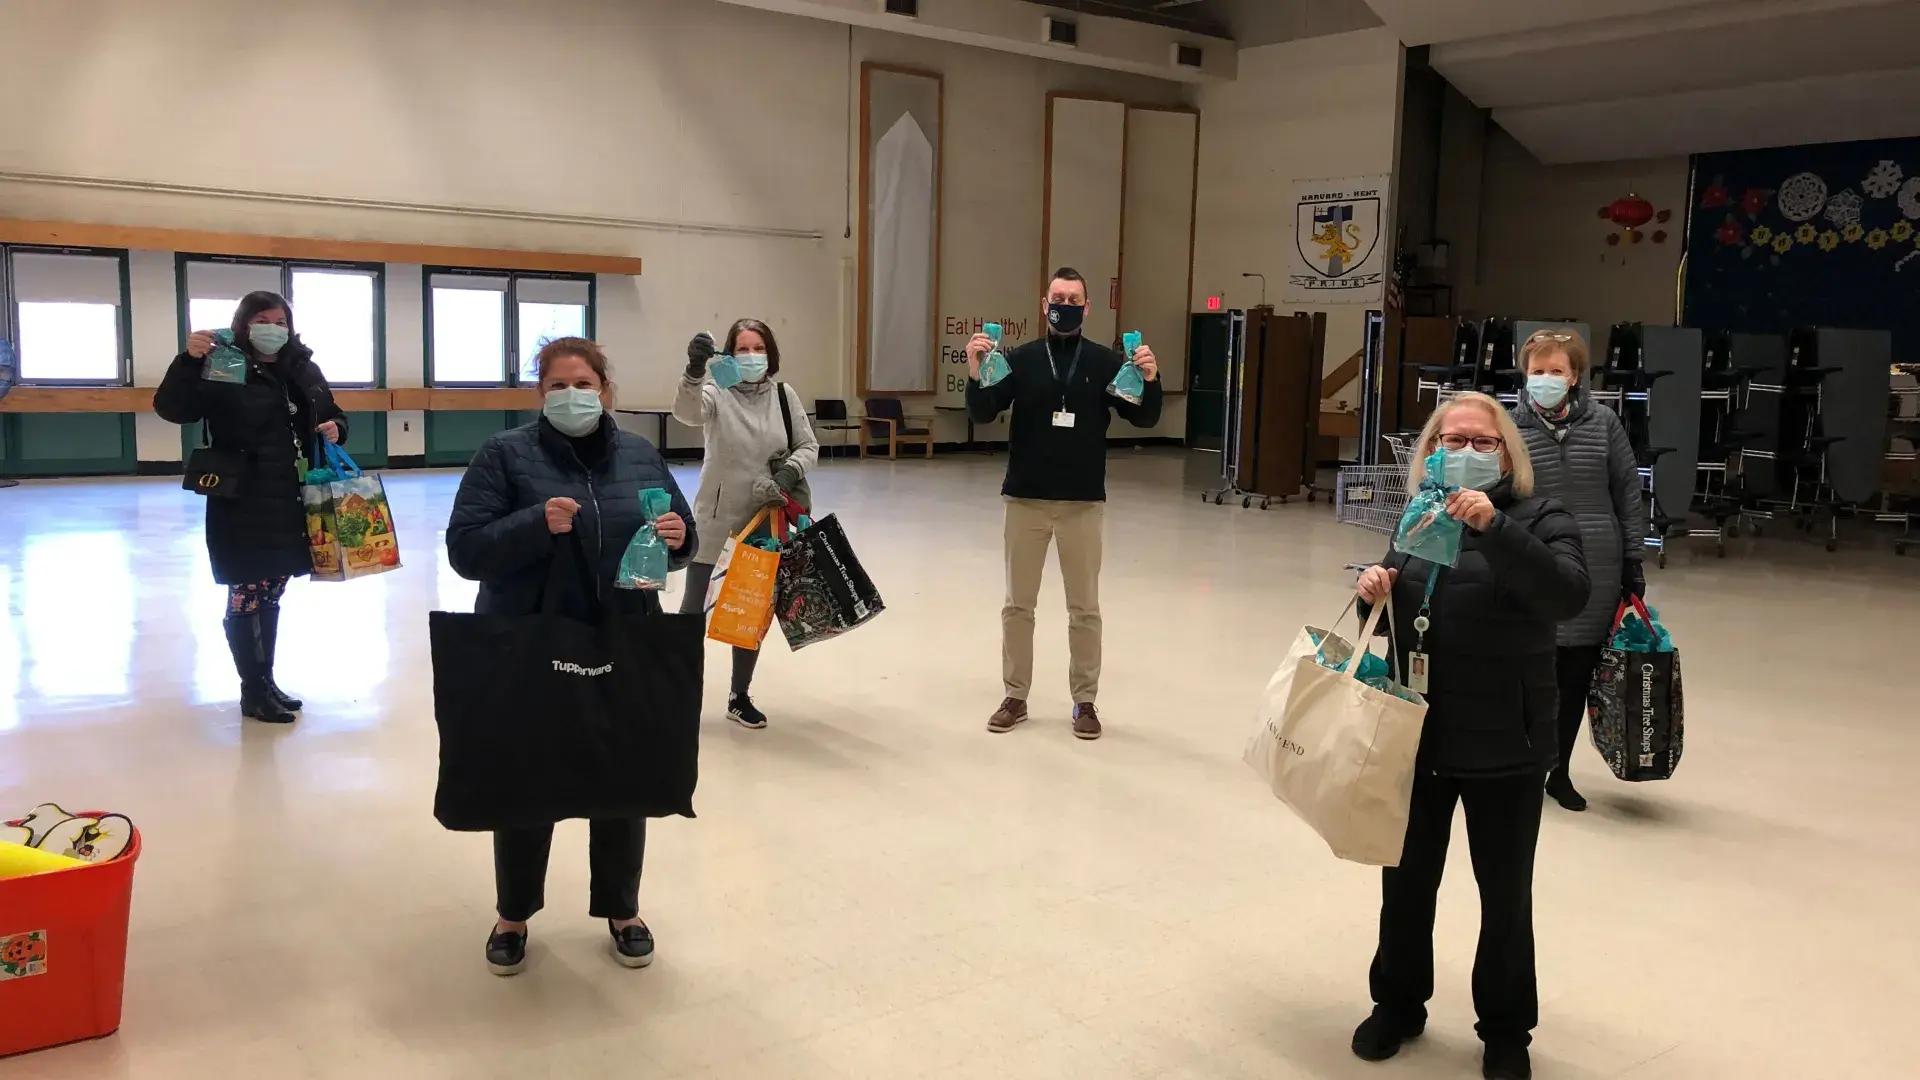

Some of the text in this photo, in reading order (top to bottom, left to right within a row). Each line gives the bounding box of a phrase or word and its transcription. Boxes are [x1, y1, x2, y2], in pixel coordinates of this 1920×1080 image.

[1301, 192, 1344, 201] HARVARD
[1353, 189, 1379, 197] KENT
[945, 316, 1027, 340] Eat Hlthy!
[946, 373, 965, 393] Be
[818, 531, 860, 602] Christmas Tree Shops
[551, 660, 613, 676] Tupperware
[1641, 663, 1655, 752] Christmas Tree Shops
[1282, 739, 1305, 756] END
